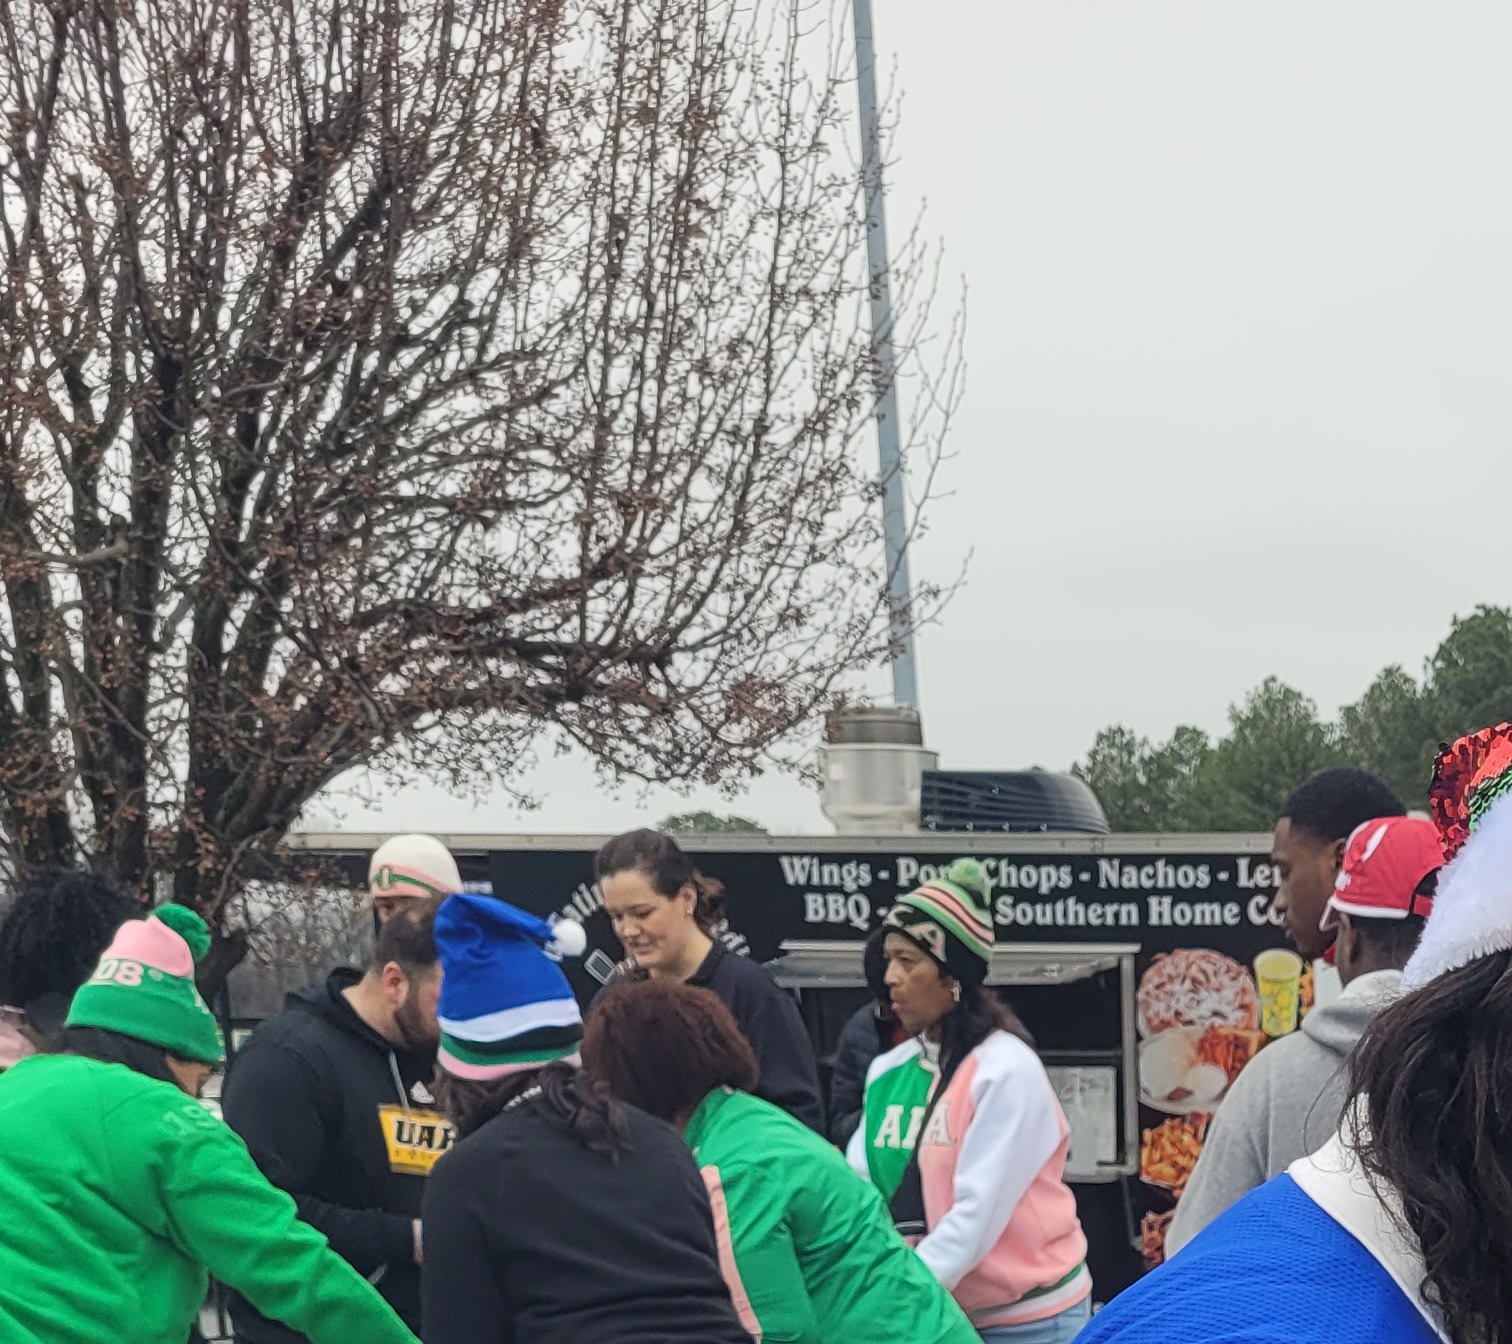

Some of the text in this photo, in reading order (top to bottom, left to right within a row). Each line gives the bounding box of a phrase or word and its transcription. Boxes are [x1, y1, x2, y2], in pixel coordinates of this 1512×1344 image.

[778, 856, 872, 892] Wings
[895, 856, 952, 887] Por
[1097, 858, 1211, 889] Nachos
[804, 893, 870, 931] BBQ
[994, 895, 1140, 926] Southern
[1147, 895, 1241, 926] Home
